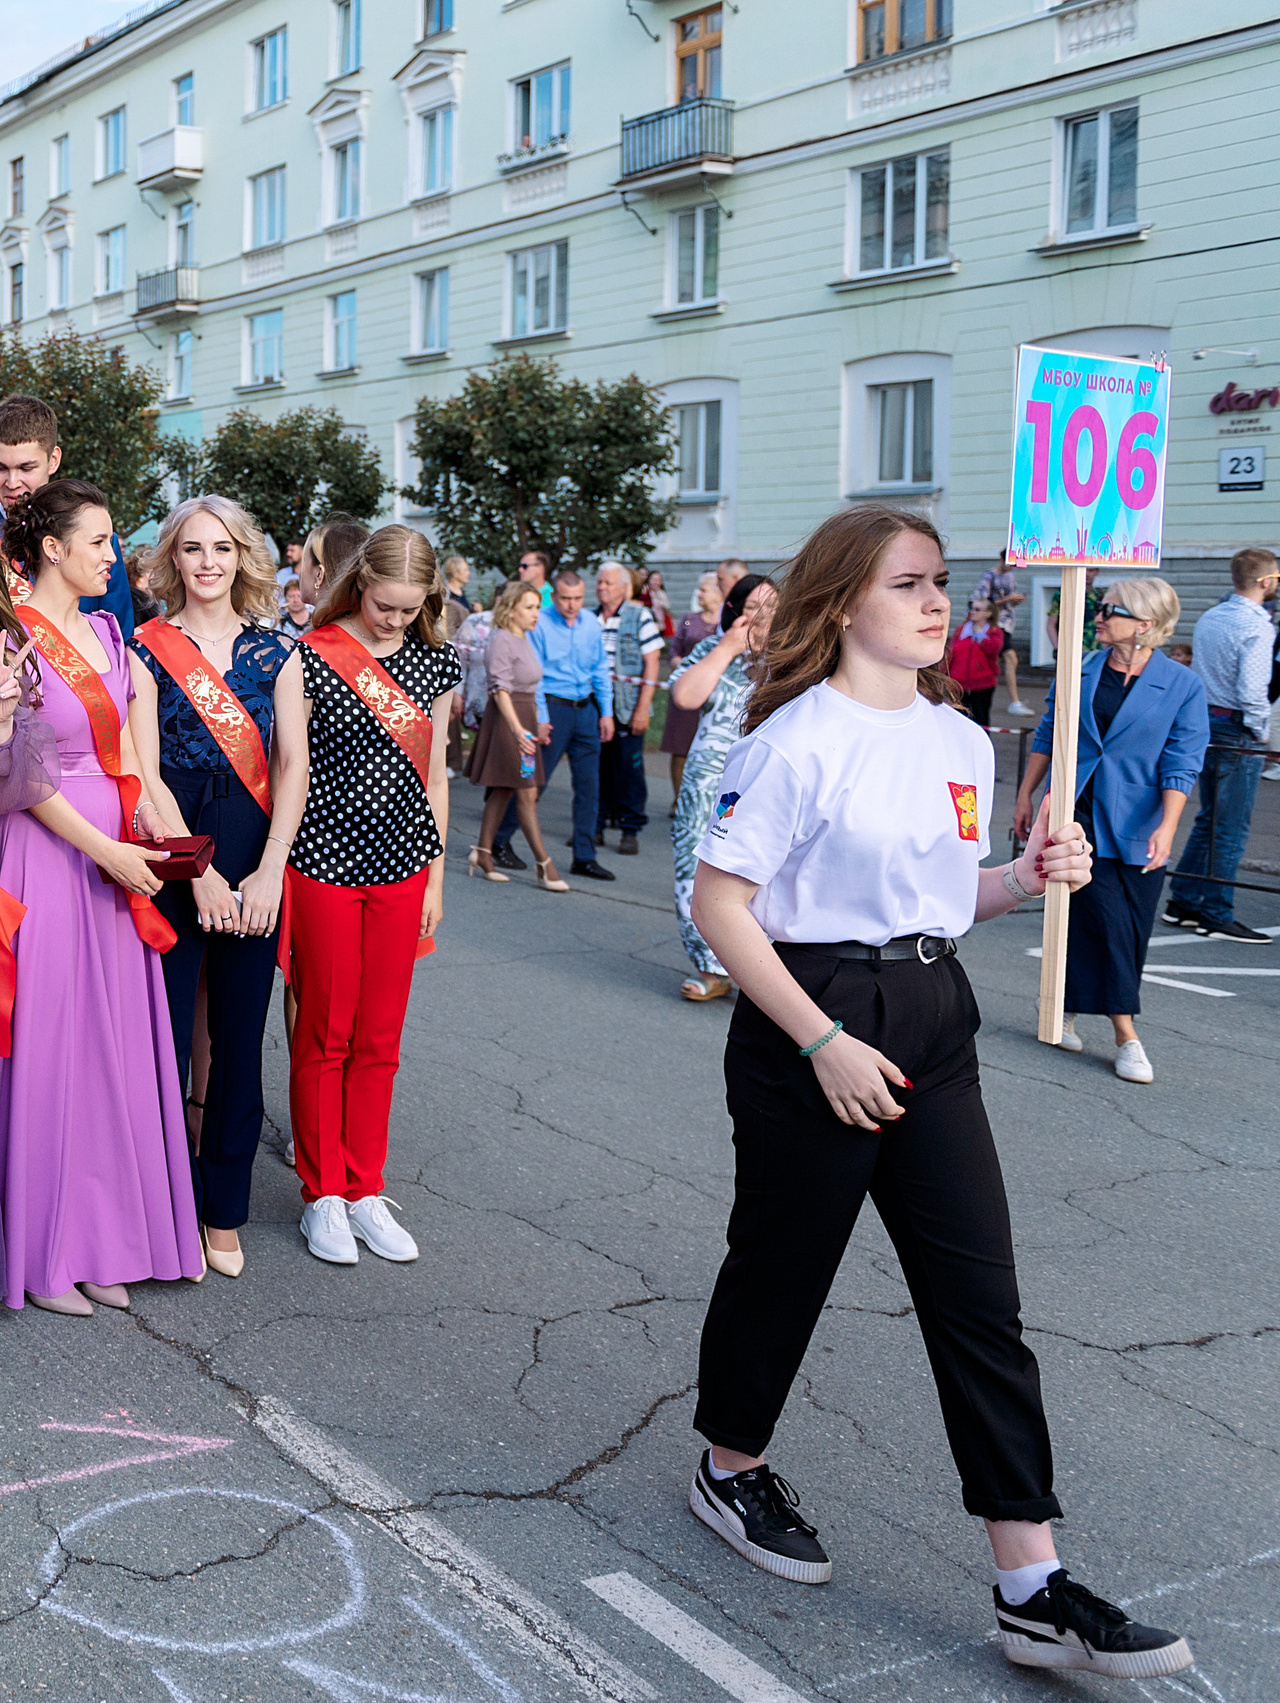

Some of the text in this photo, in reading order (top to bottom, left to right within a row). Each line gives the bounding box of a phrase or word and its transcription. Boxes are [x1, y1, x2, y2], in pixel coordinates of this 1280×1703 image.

[1042, 368, 1152, 396] МБОУ ШКОЛА №
[1025, 400, 1160, 511] 106
[1228, 456, 1255, 474] 23
[54, 656, 115, 766] Выпускни
